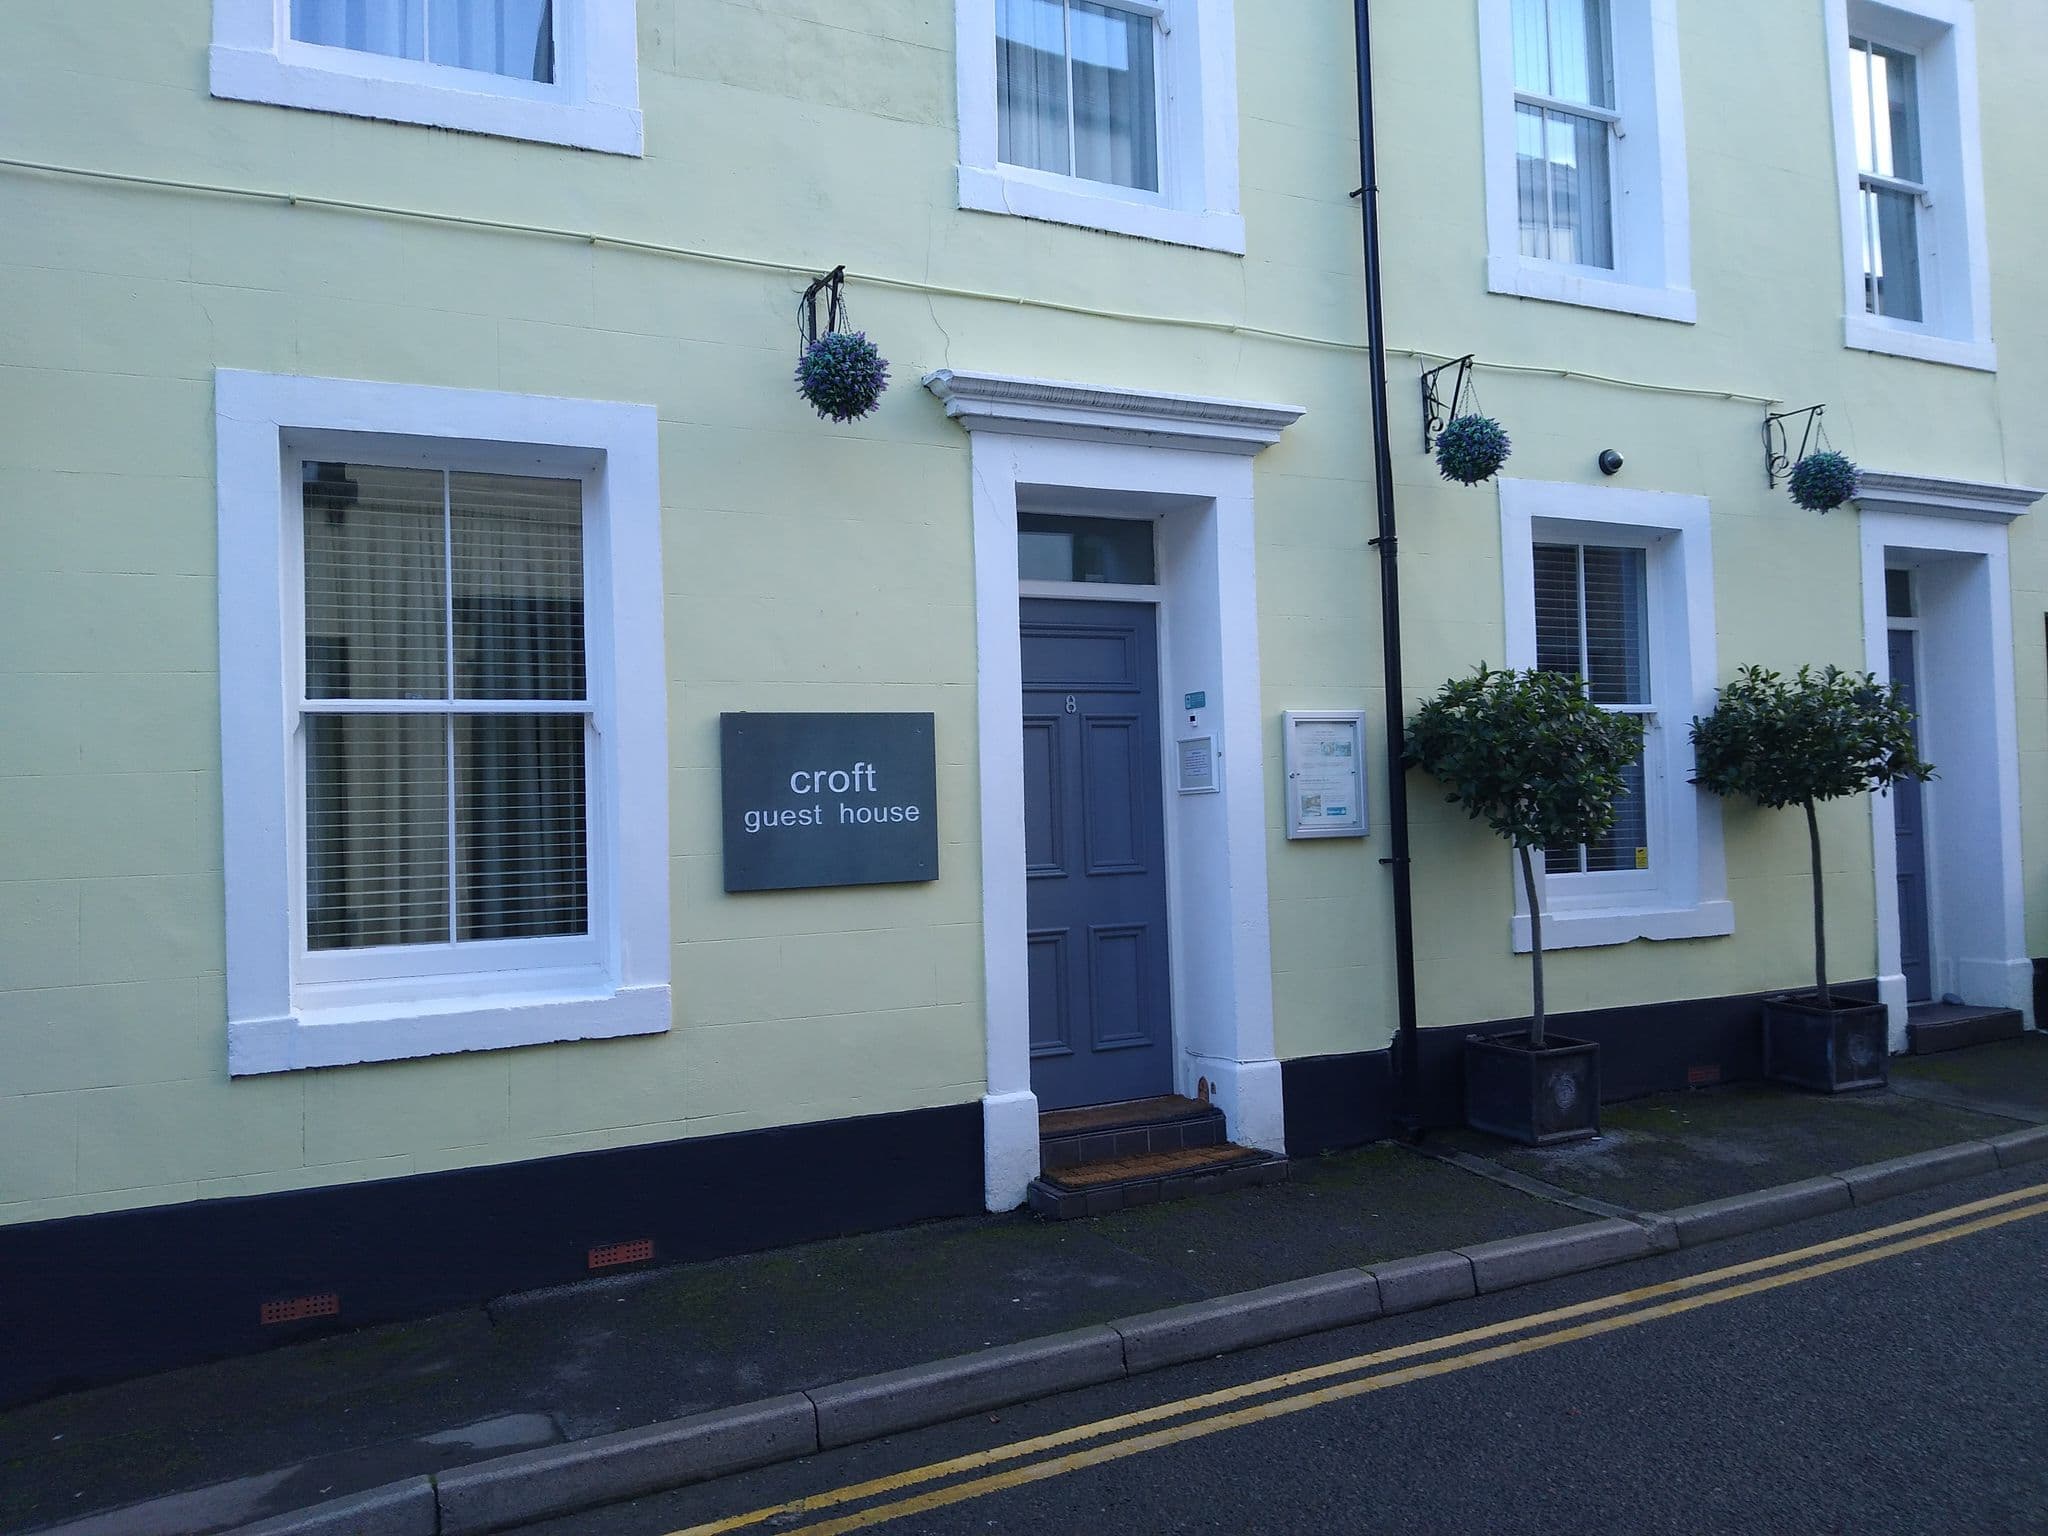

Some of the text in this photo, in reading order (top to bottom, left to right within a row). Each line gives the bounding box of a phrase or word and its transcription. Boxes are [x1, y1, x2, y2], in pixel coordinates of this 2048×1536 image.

[1066, 694, 1077, 714] 8
[790, 761, 877, 794] croft
[744, 803, 921, 833] guest house
